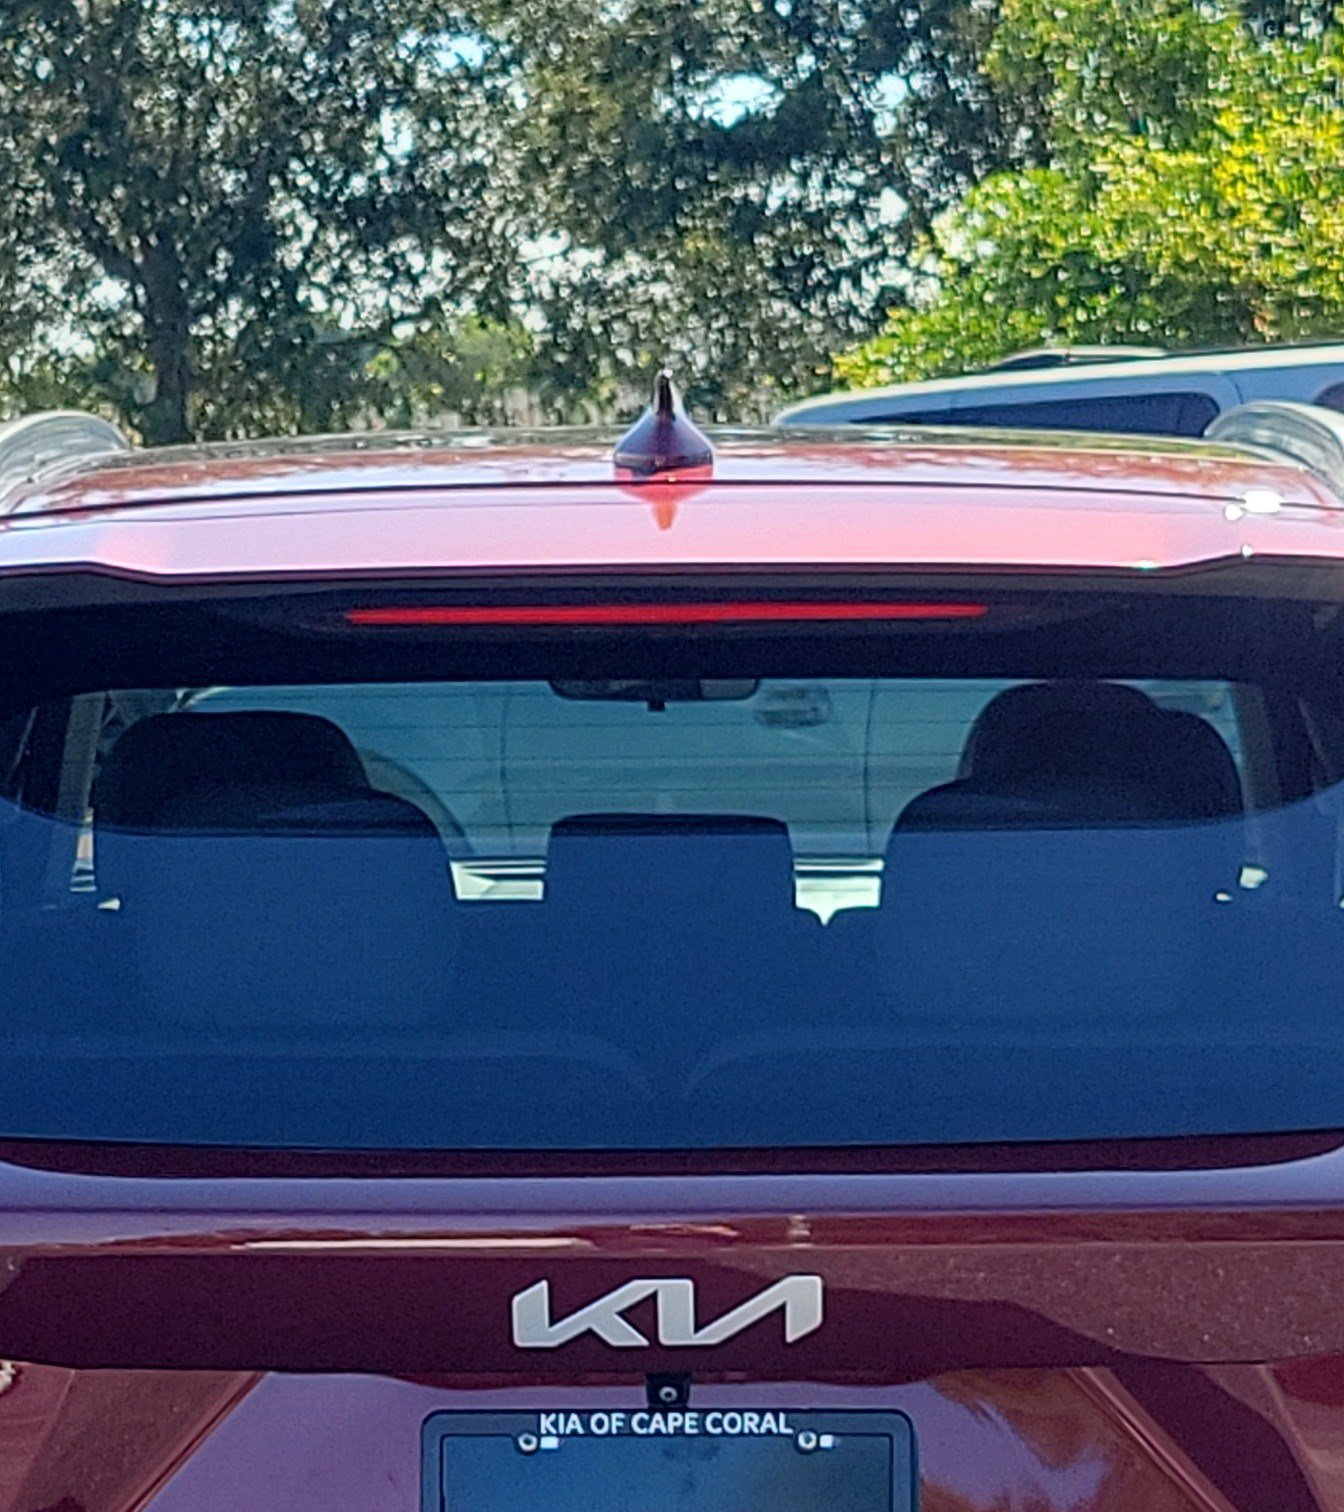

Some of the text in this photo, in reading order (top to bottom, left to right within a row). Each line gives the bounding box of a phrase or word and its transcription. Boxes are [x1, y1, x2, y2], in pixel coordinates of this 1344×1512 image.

[512, 1276, 823, 1347] KIA
[539, 1412, 794, 1435] KIA OF CAPE CORAL
